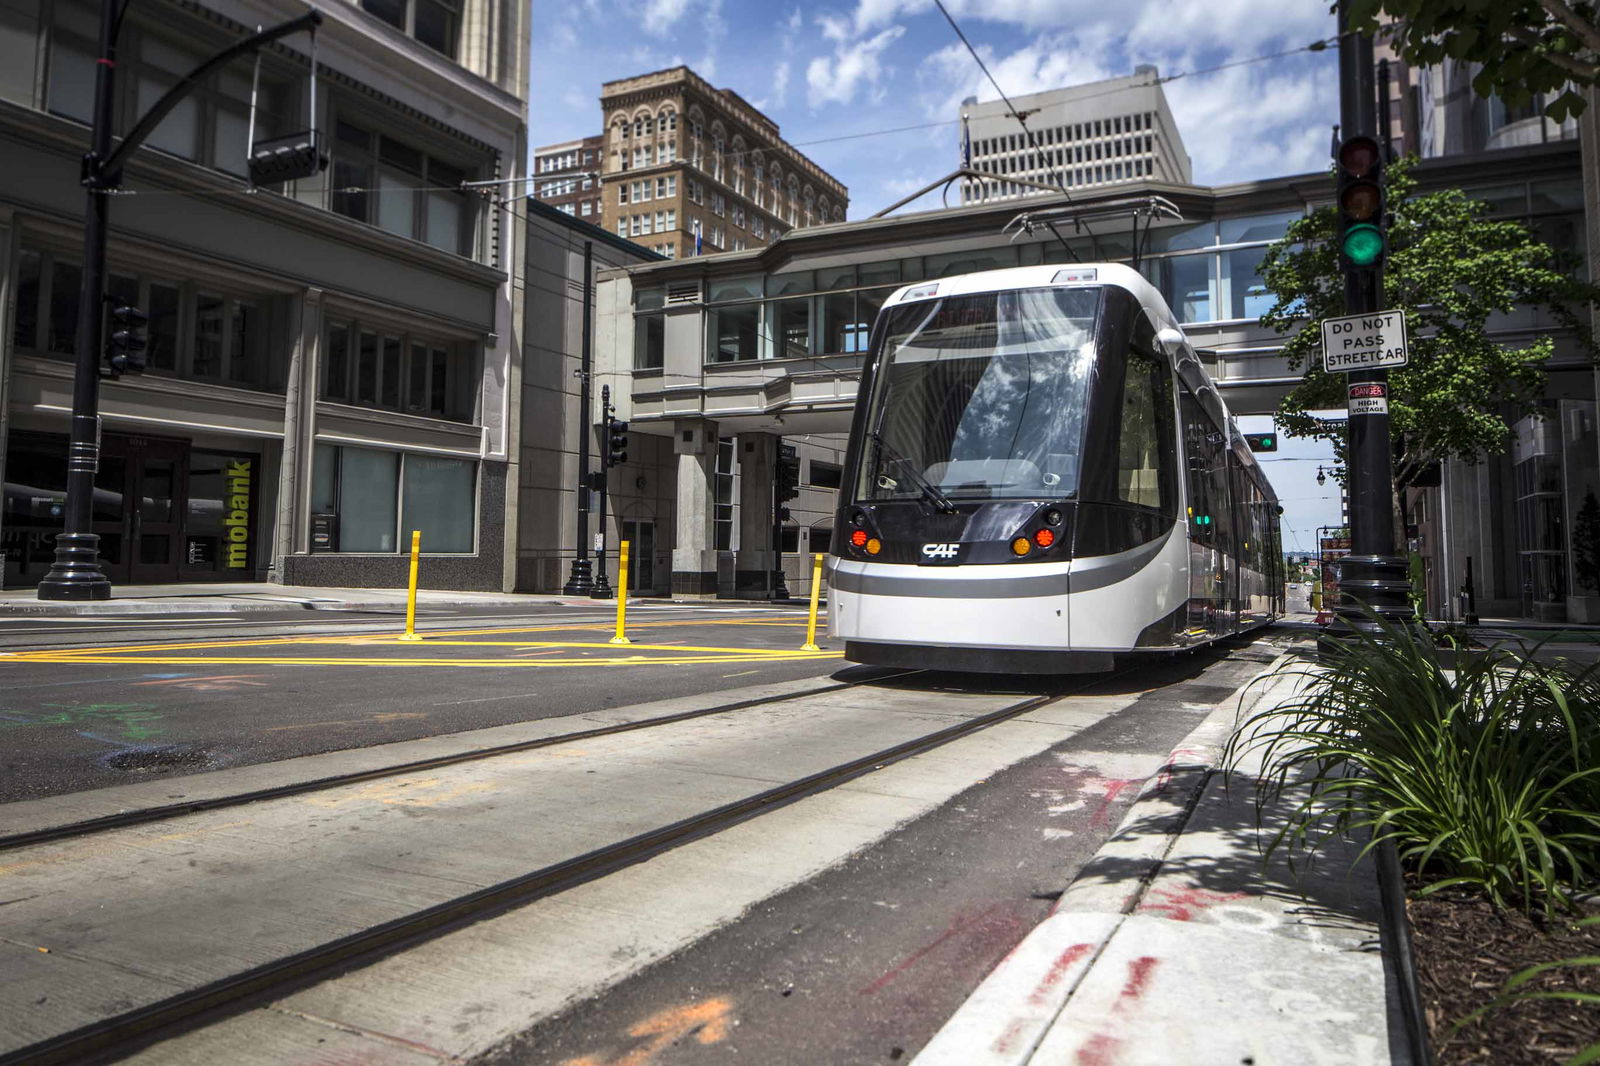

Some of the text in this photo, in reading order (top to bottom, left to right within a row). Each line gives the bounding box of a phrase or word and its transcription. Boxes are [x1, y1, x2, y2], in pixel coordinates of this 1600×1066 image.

[1332, 317, 1392, 335] DO NOT
[1343, 335, 1385, 350] PASS
[1328, 348, 1403, 366] STREETCAR
[226, 460, 251, 568] mobank
[922, 543, 960, 558] CAF
